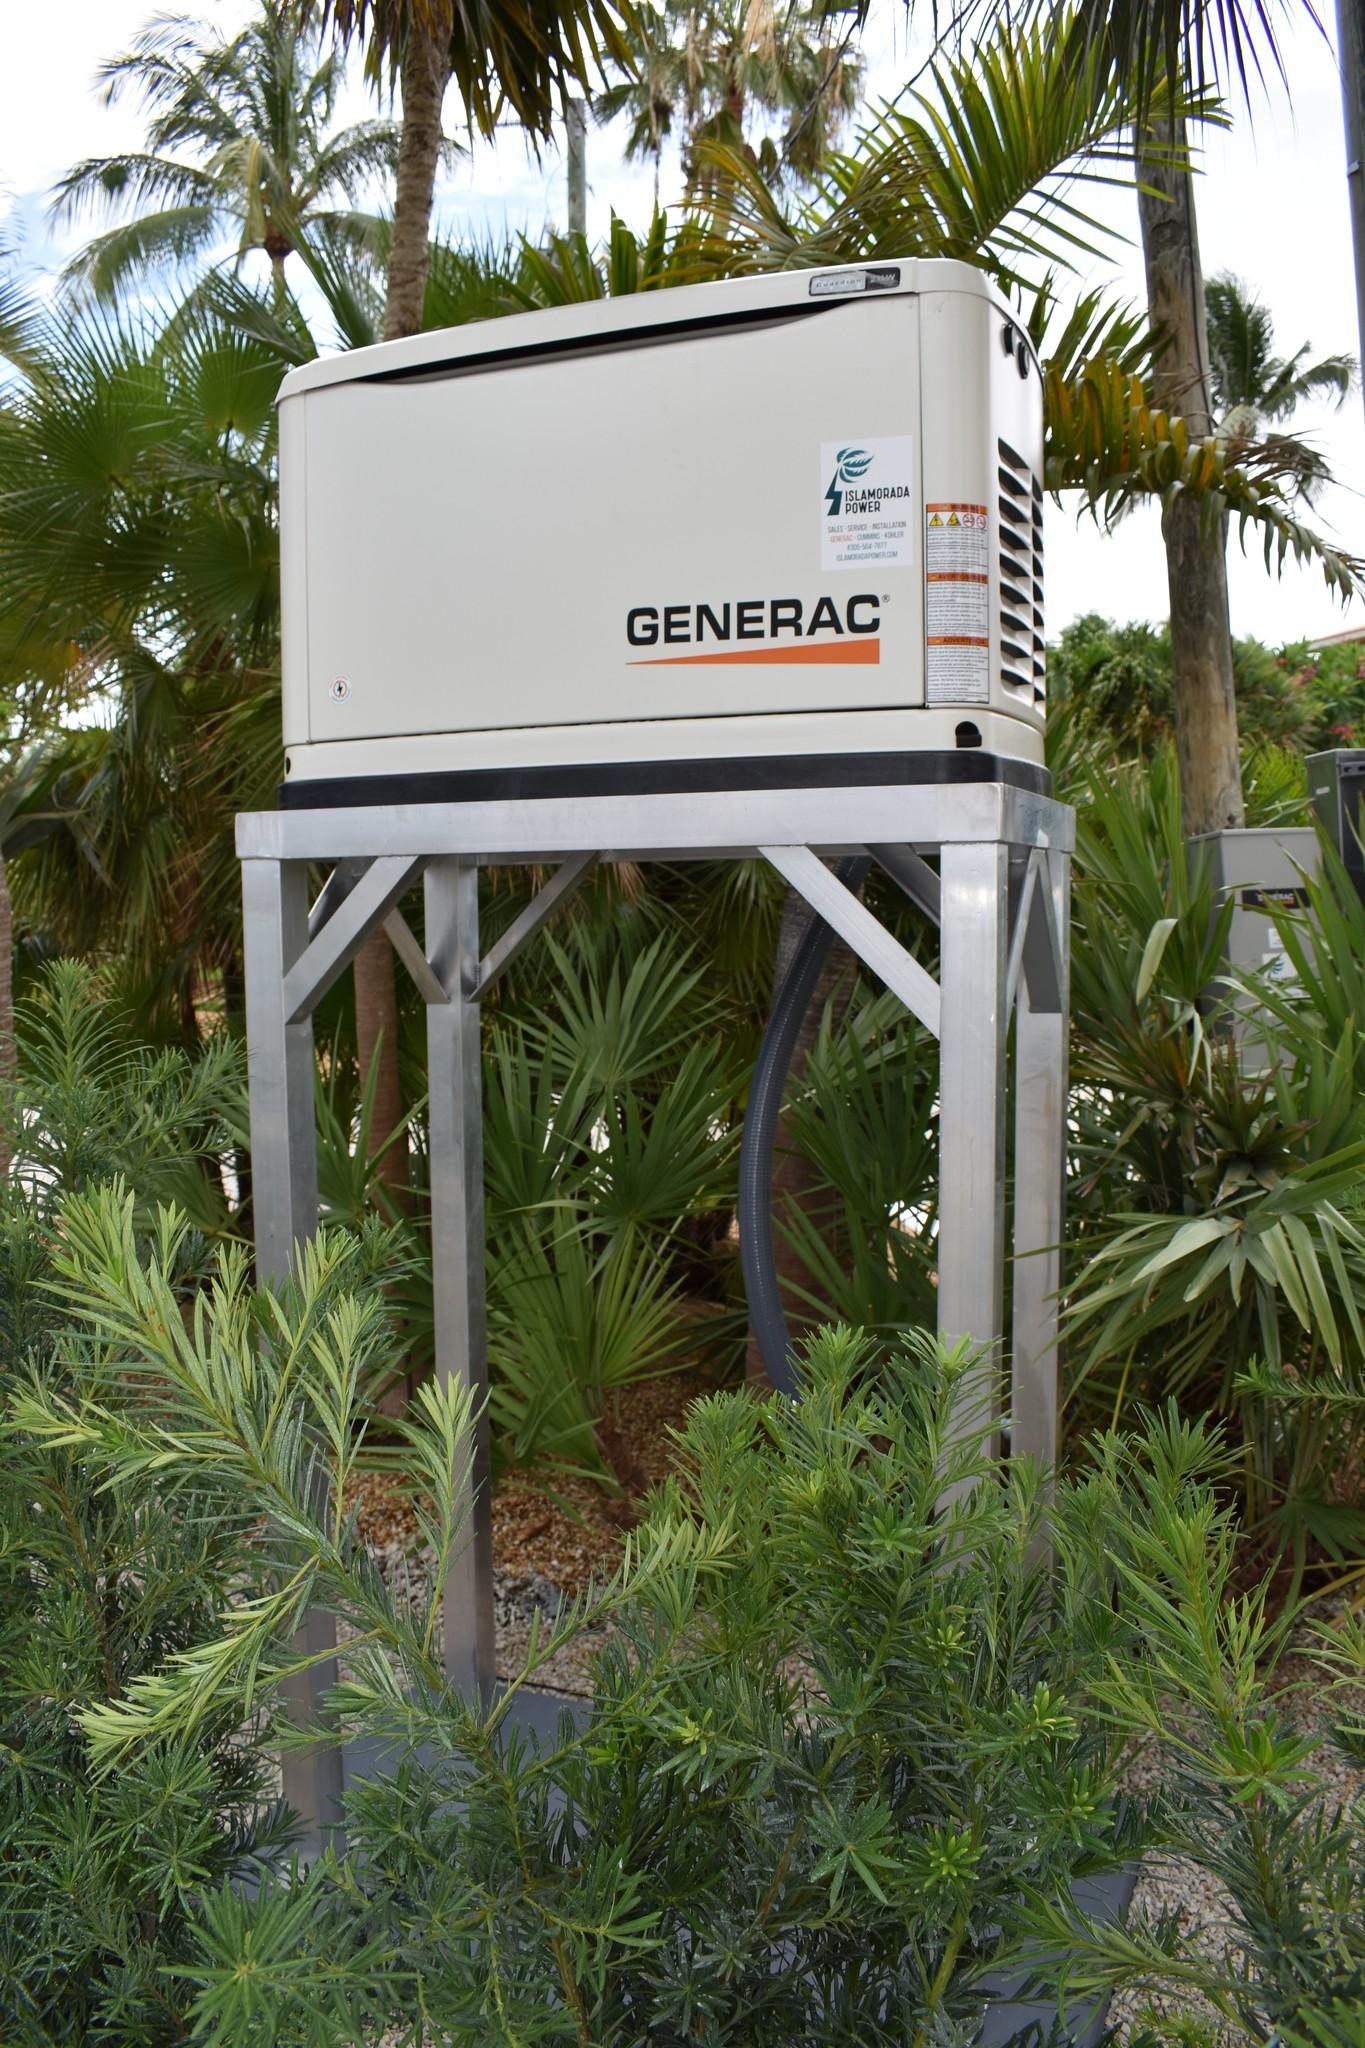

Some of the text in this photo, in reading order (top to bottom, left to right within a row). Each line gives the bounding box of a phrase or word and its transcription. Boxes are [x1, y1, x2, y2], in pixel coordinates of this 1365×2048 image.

[845, 486, 910, 502] ISLAMORADA
[845, 501, 881, 515] POWER
[828, 520, 907, 534] SALES SERVICE INSTALLATION
[884, 530, 904, 539] KOHLER
[627, 594, 880, 646] GENERAC
